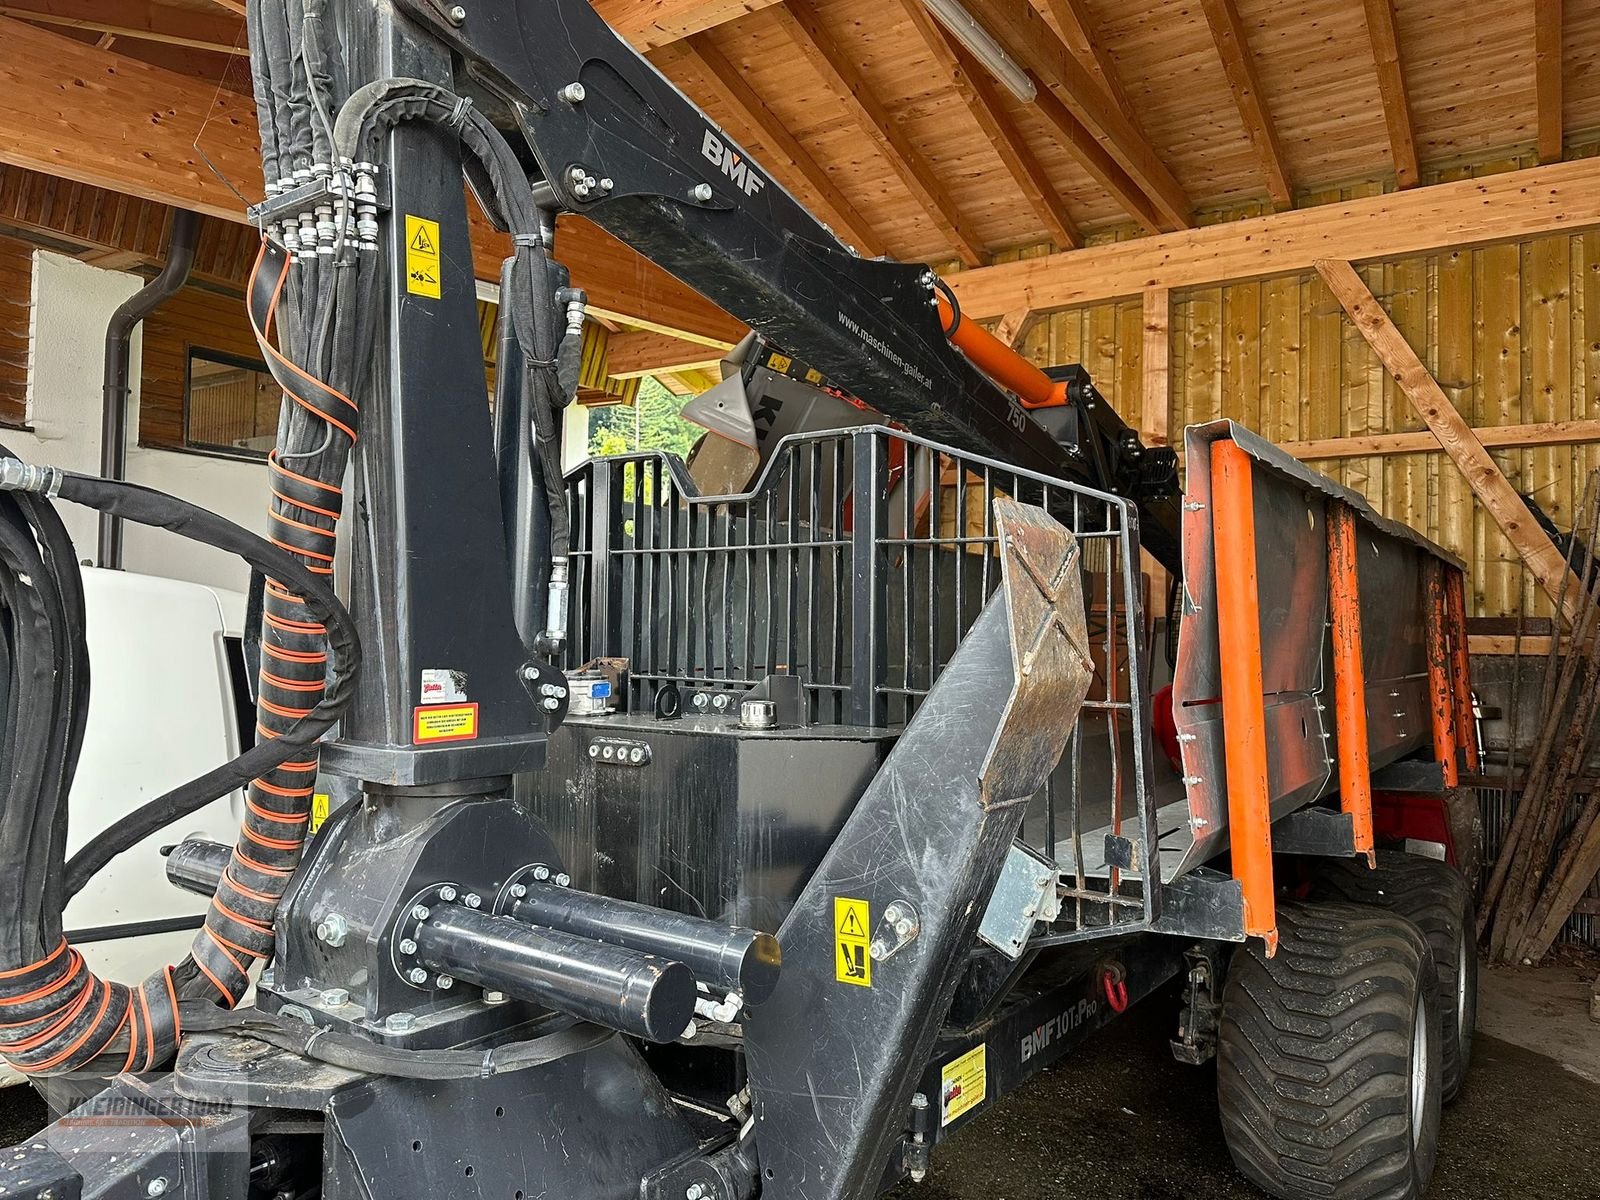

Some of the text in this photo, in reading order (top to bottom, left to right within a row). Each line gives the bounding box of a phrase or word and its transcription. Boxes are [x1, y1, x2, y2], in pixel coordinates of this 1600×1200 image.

[701, 128, 765, 197] BMF
[838, 311, 933, 391] www.maschinen-gailer.at
[1007, 400, 1026, 433] 750
